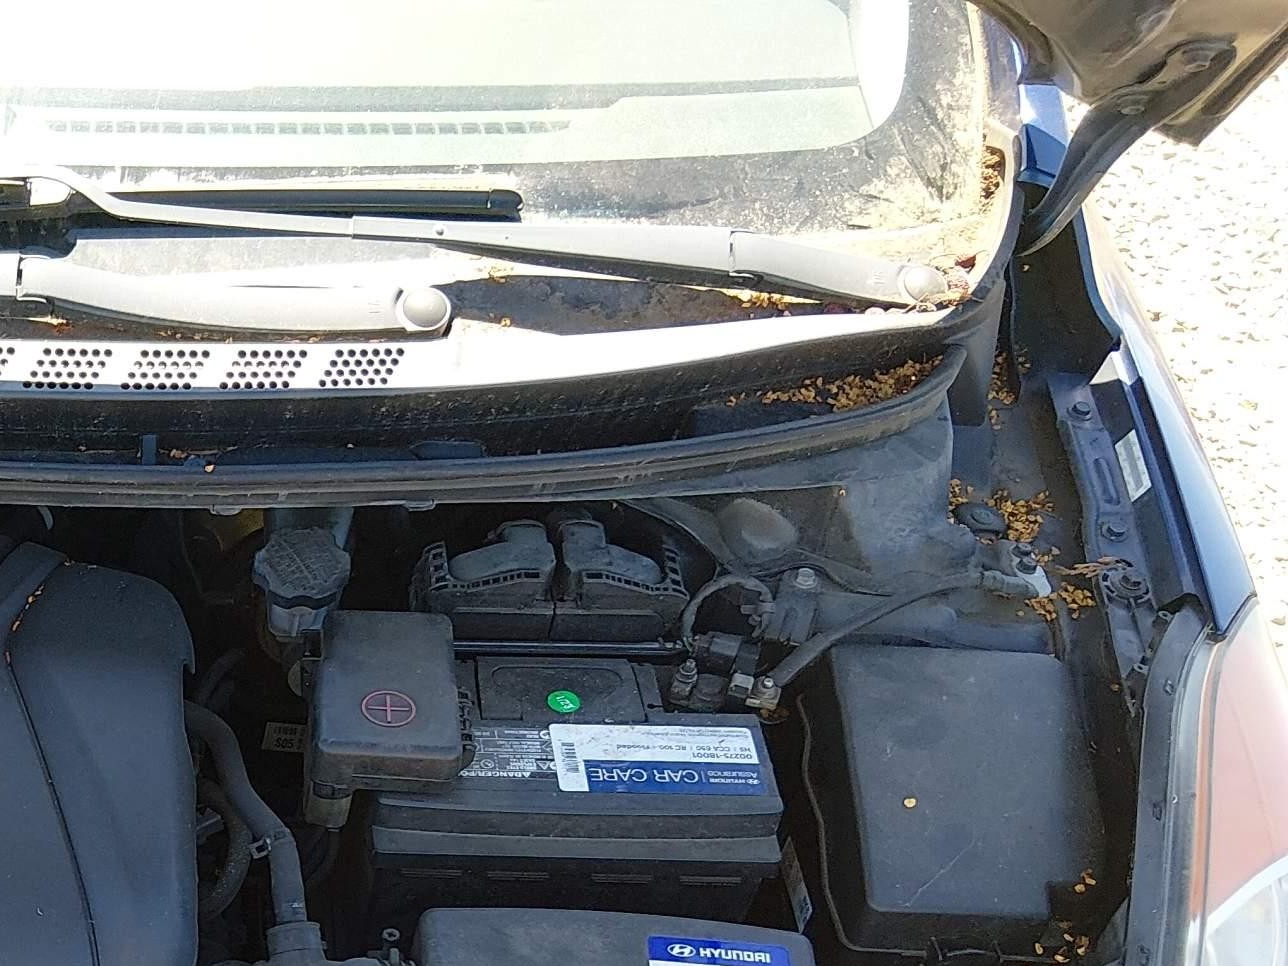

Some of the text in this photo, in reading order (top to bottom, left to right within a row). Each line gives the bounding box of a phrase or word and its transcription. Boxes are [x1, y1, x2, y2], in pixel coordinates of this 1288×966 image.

[589, 767, 698, 783] CAR CARE
[707, 770, 757, 779] Assurance
[699, 947, 772, 964] HYUNDAI
